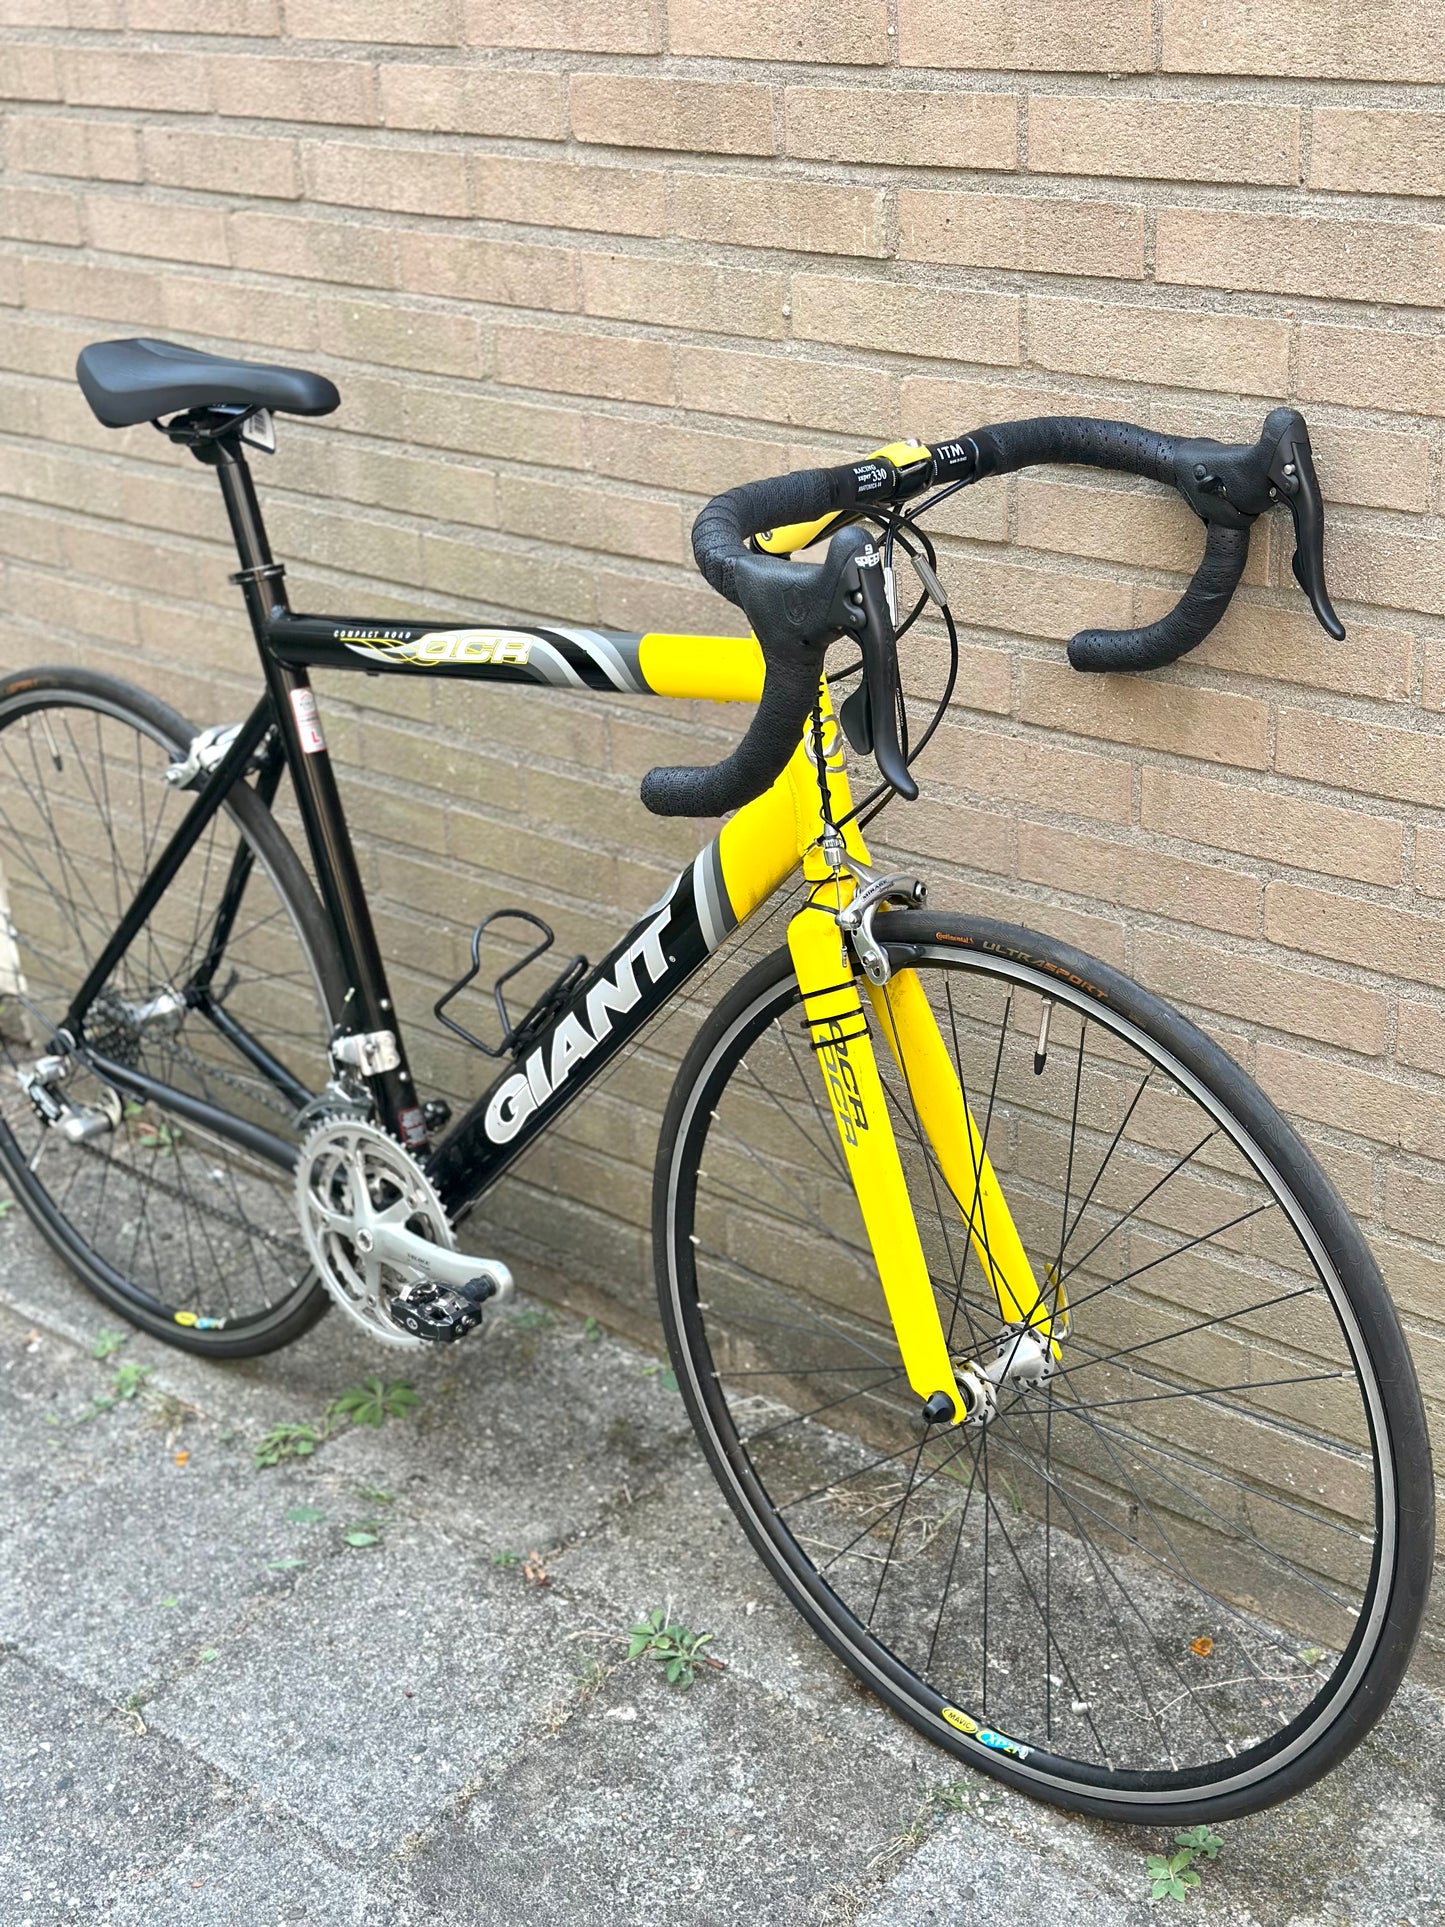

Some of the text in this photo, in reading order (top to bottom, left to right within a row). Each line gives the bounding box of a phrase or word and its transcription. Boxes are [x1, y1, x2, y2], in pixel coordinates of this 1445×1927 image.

[936, 443, 965, 460] ITM
[853, 464, 876, 474] RACING
[871, 467, 887, 482] 330
[865, 544, 873, 555] 9
[333, 629, 411, 639] COMPACT ROAD
[416, 633, 535, 665] OCR
[935, 931, 970, 944] Continental
[484, 903, 672, 1144] GIANT
[948, 1712, 971, 1729] MAVIC
